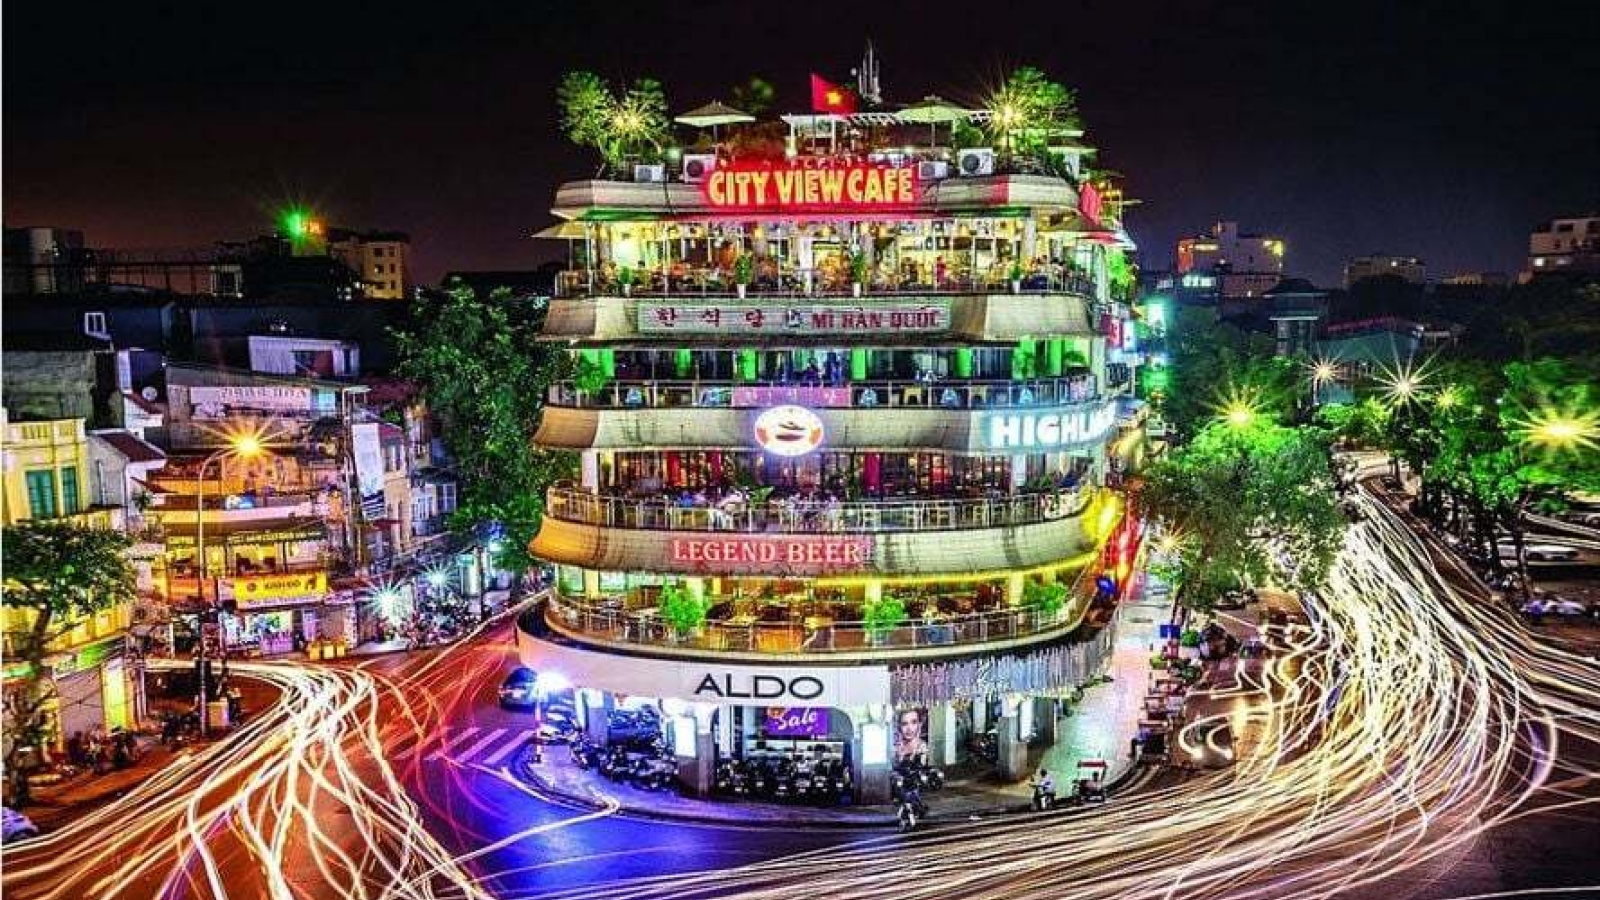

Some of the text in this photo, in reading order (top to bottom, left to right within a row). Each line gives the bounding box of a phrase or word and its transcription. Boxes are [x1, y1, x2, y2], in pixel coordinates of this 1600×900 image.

[708, 168, 913, 205] CITY VIEW CAFE
[673, 540, 862, 564] LEGEND BEER
[694, 673, 824, 699] ALDO
[776, 706, 818, 730] Sale
